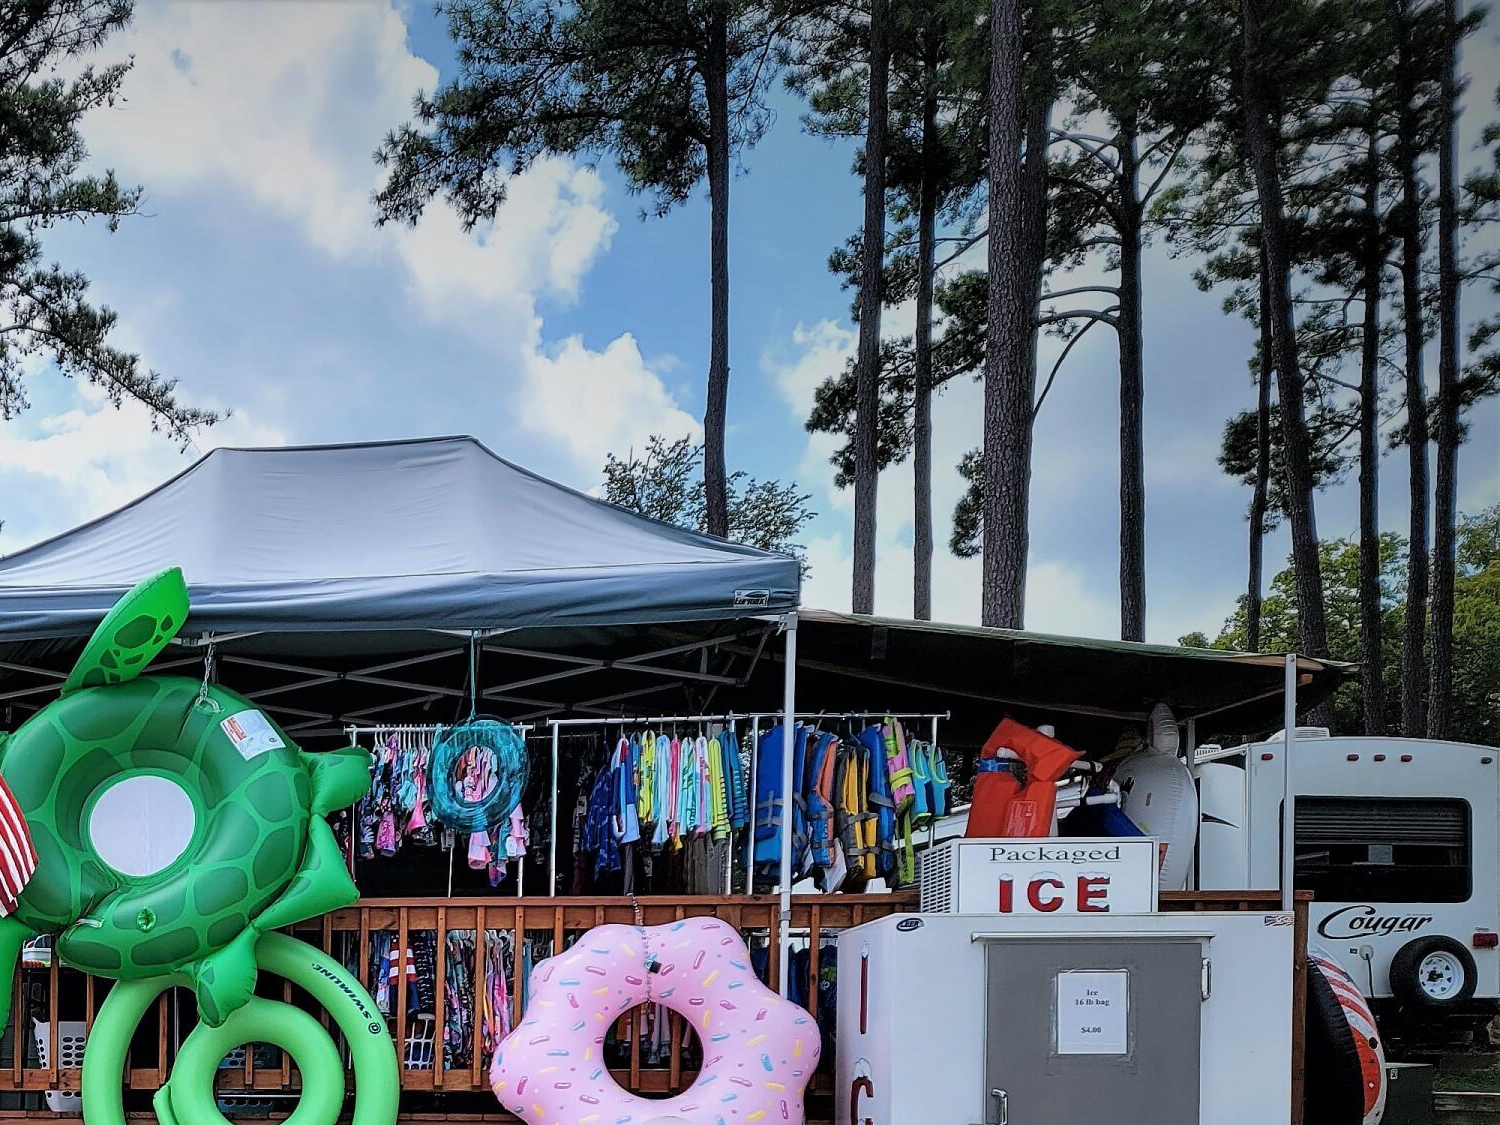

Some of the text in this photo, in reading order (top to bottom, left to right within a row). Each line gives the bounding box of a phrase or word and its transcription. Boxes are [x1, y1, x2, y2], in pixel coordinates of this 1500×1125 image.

[989, 846, 1123, 865] Packaged
[998, 871, 1111, 913] ICE
[1317, 904, 1433, 940] Cougar
[313, 963, 373, 1020] SWIMLINE
[1086, 988, 1099, 996] Ice
[1095, 998, 1111, 1007] bag
